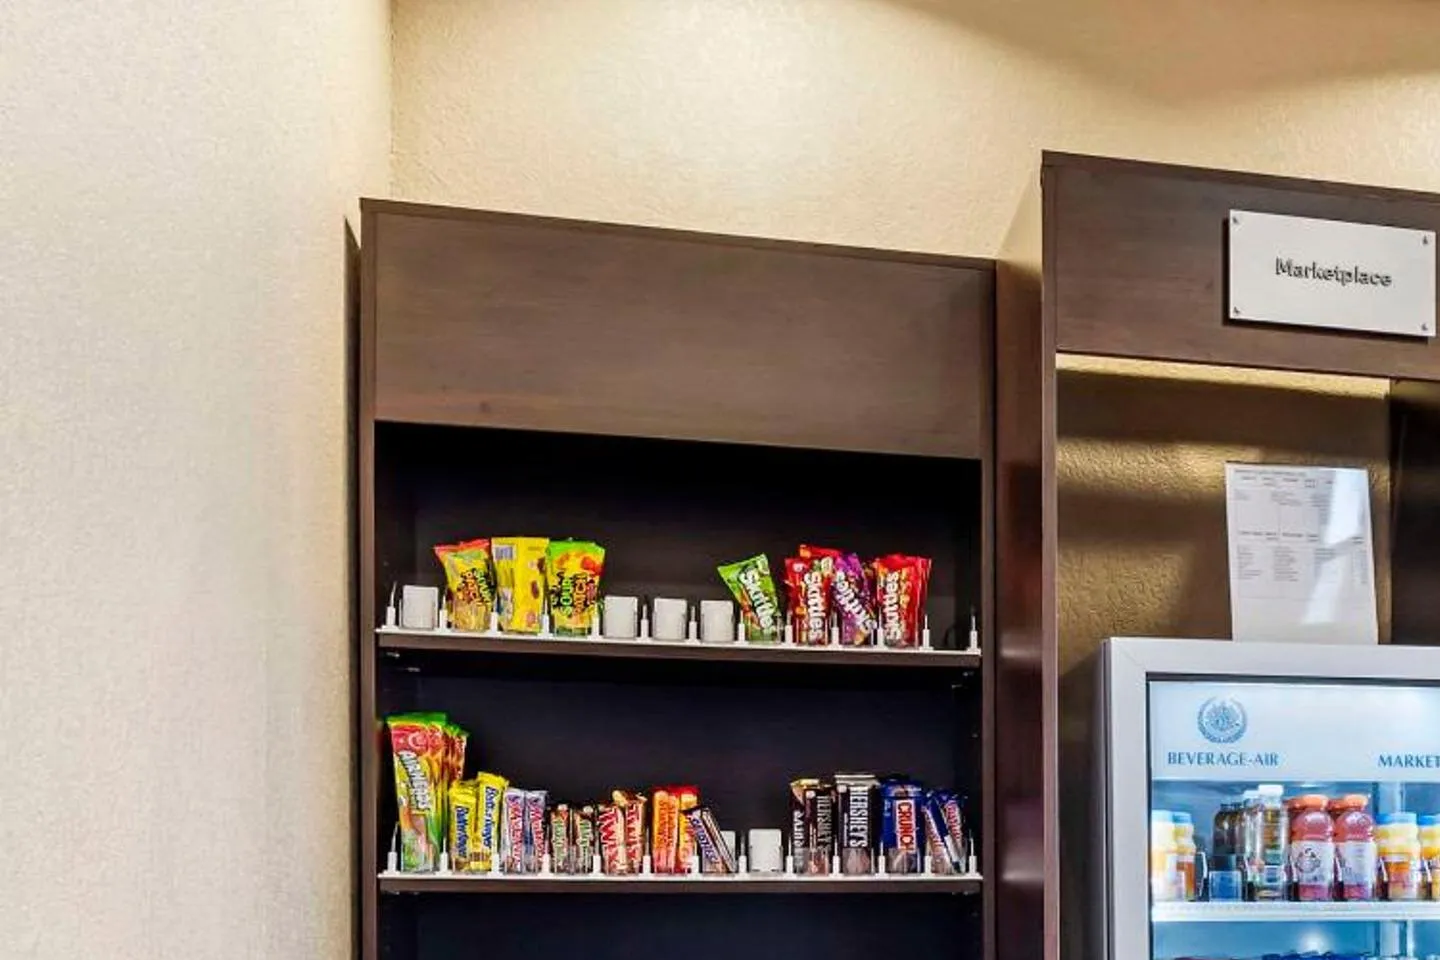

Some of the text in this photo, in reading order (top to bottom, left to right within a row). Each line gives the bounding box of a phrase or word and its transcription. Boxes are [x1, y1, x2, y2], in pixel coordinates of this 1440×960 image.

[1275, 256, 1392, 287] Marketplace
[803, 572, 827, 641] Skittles
[832, 571, 878, 632] Skittles
[884, 571, 901, 641] Skittles
[1168, 752, 1279, 767] BEVERAGE-AIR
[849, 786, 869, 848] HERSHEY'S
[898, 802, 913, 853] CRUNCH
